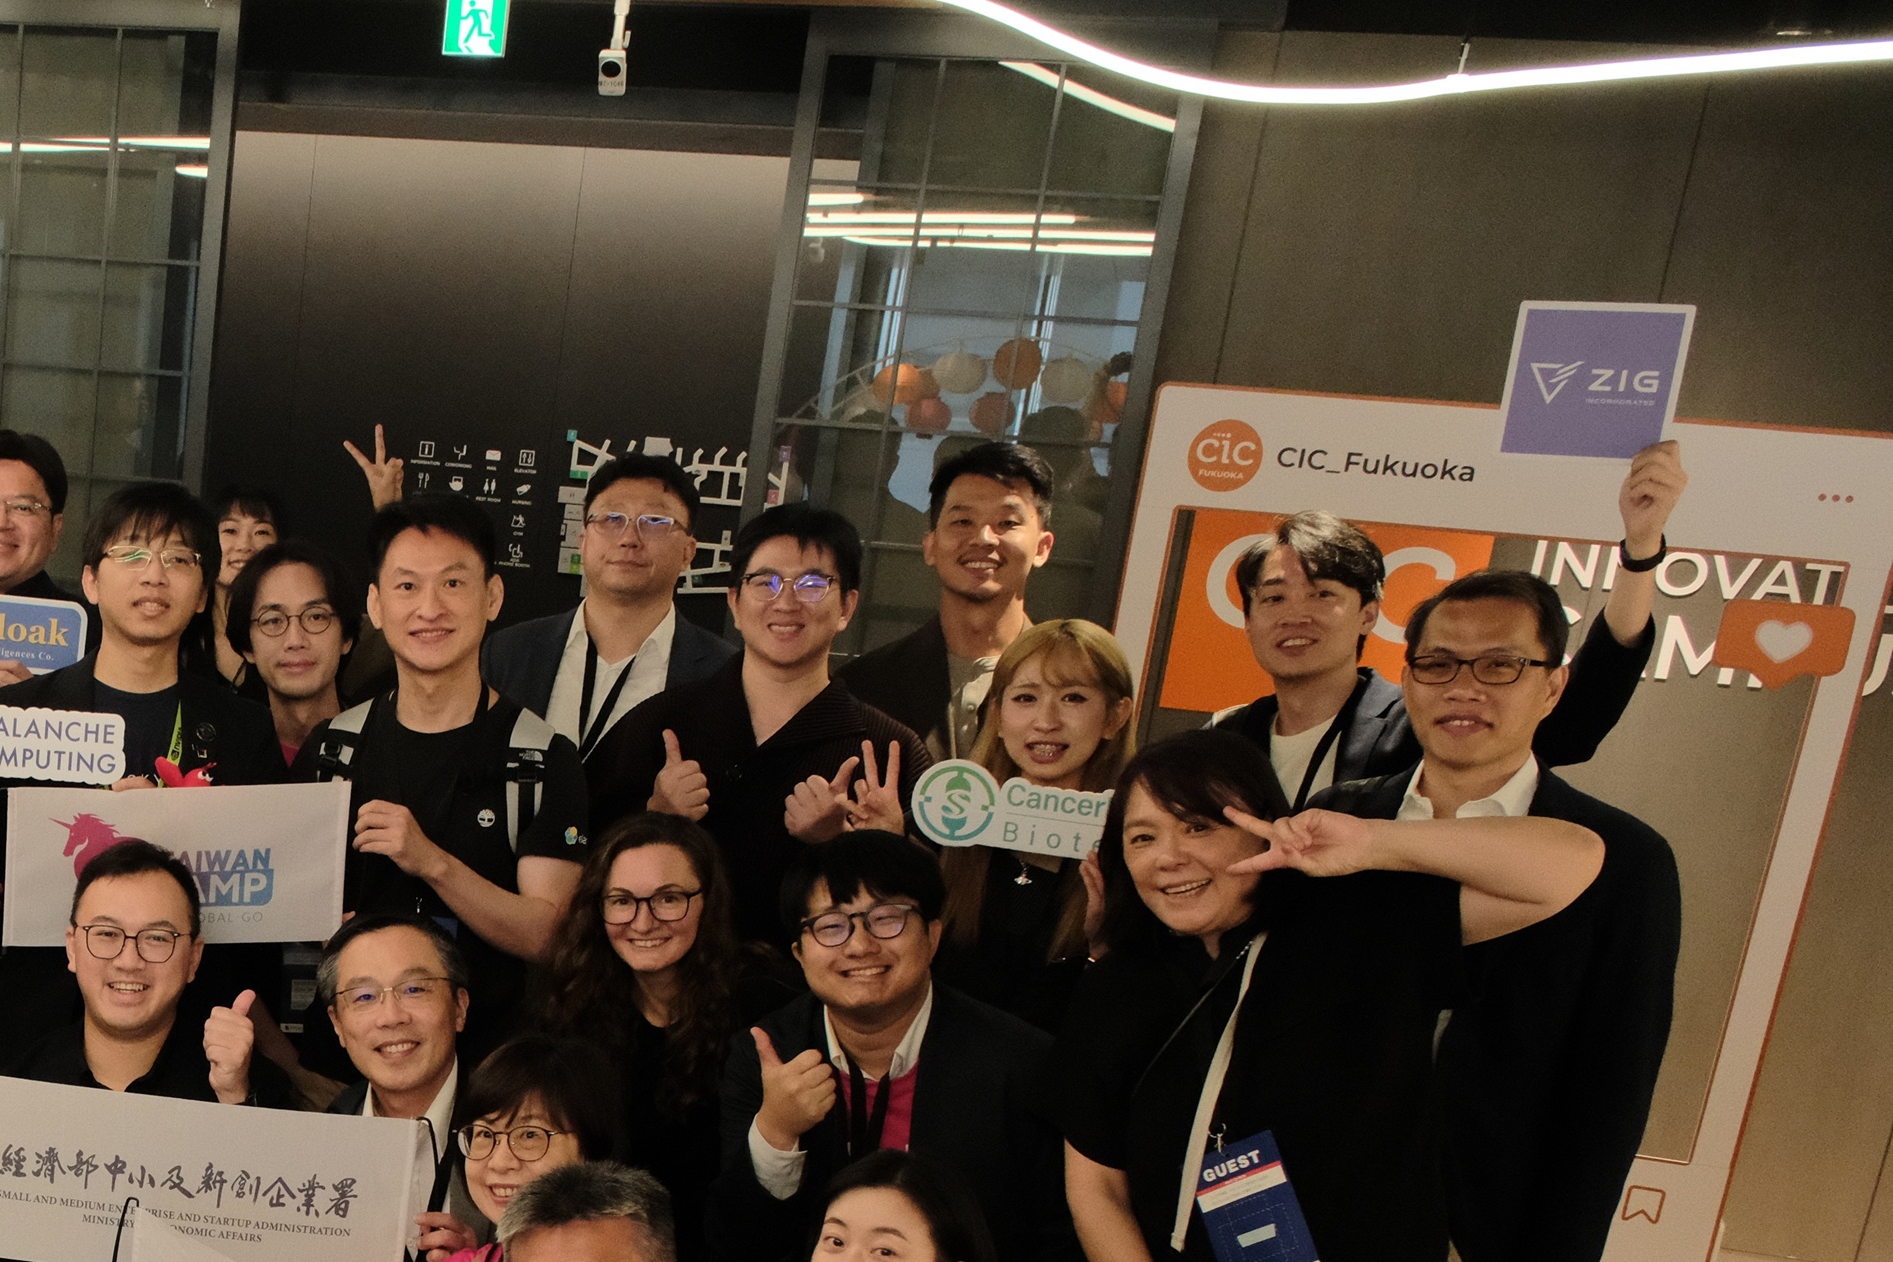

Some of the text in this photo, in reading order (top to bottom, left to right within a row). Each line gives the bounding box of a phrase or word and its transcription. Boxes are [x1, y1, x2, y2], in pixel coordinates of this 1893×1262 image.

[1588, 368, 1660, 394] ZIG
[1198, 469, 1244, 481] FUKUOKA
[1277, 446, 1476, 483] CIC_Fukuoka
[1206, 533, 1457, 645] CC
[38, 651, 55, 662] Co.
[1007, 783, 1111, 818] Cancer
[174, 848, 271, 873] AIWAN
[1203, 1149, 1261, 1183] GUEST
[32, 1194, 57, 1206] AND
[59, 1197, 106, 1212] MEDIUM
[174, 1212, 201, 1223] AND
[203, 1214, 252, 1229] STARTUP
[254, 1221, 351, 1237] ADMINISTRATION
[217, 1230, 262, 1243] AFFAIRS
